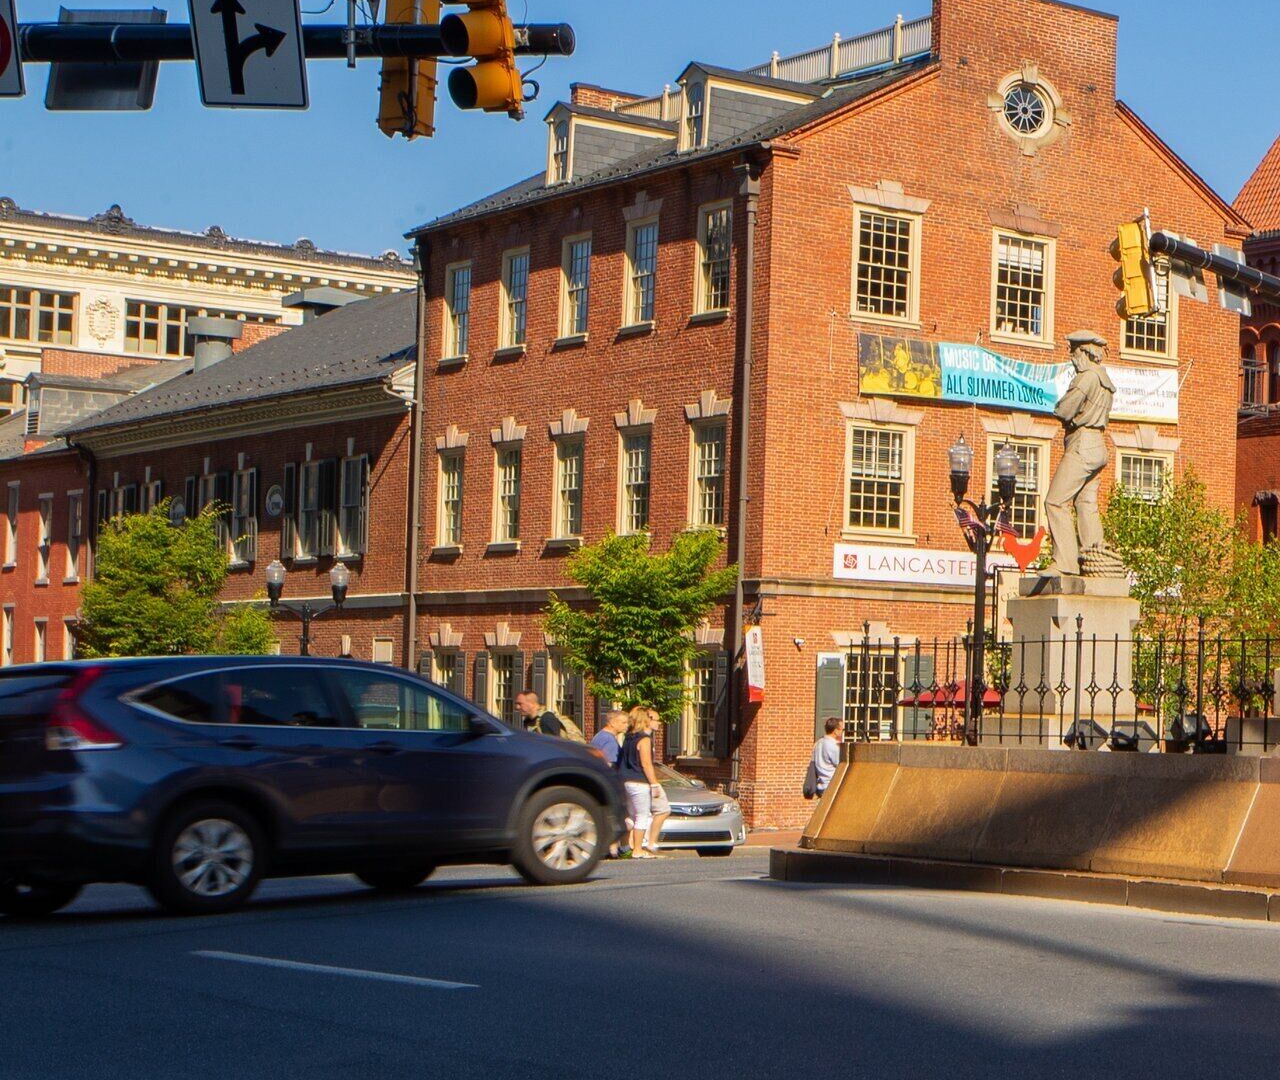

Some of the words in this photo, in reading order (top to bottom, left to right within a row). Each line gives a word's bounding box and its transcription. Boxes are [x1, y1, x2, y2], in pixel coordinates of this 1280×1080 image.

[943, 347, 979, 371] MUSIC
[946, 374, 965, 395] ALL
[967, 376, 1015, 402] SUMMER
